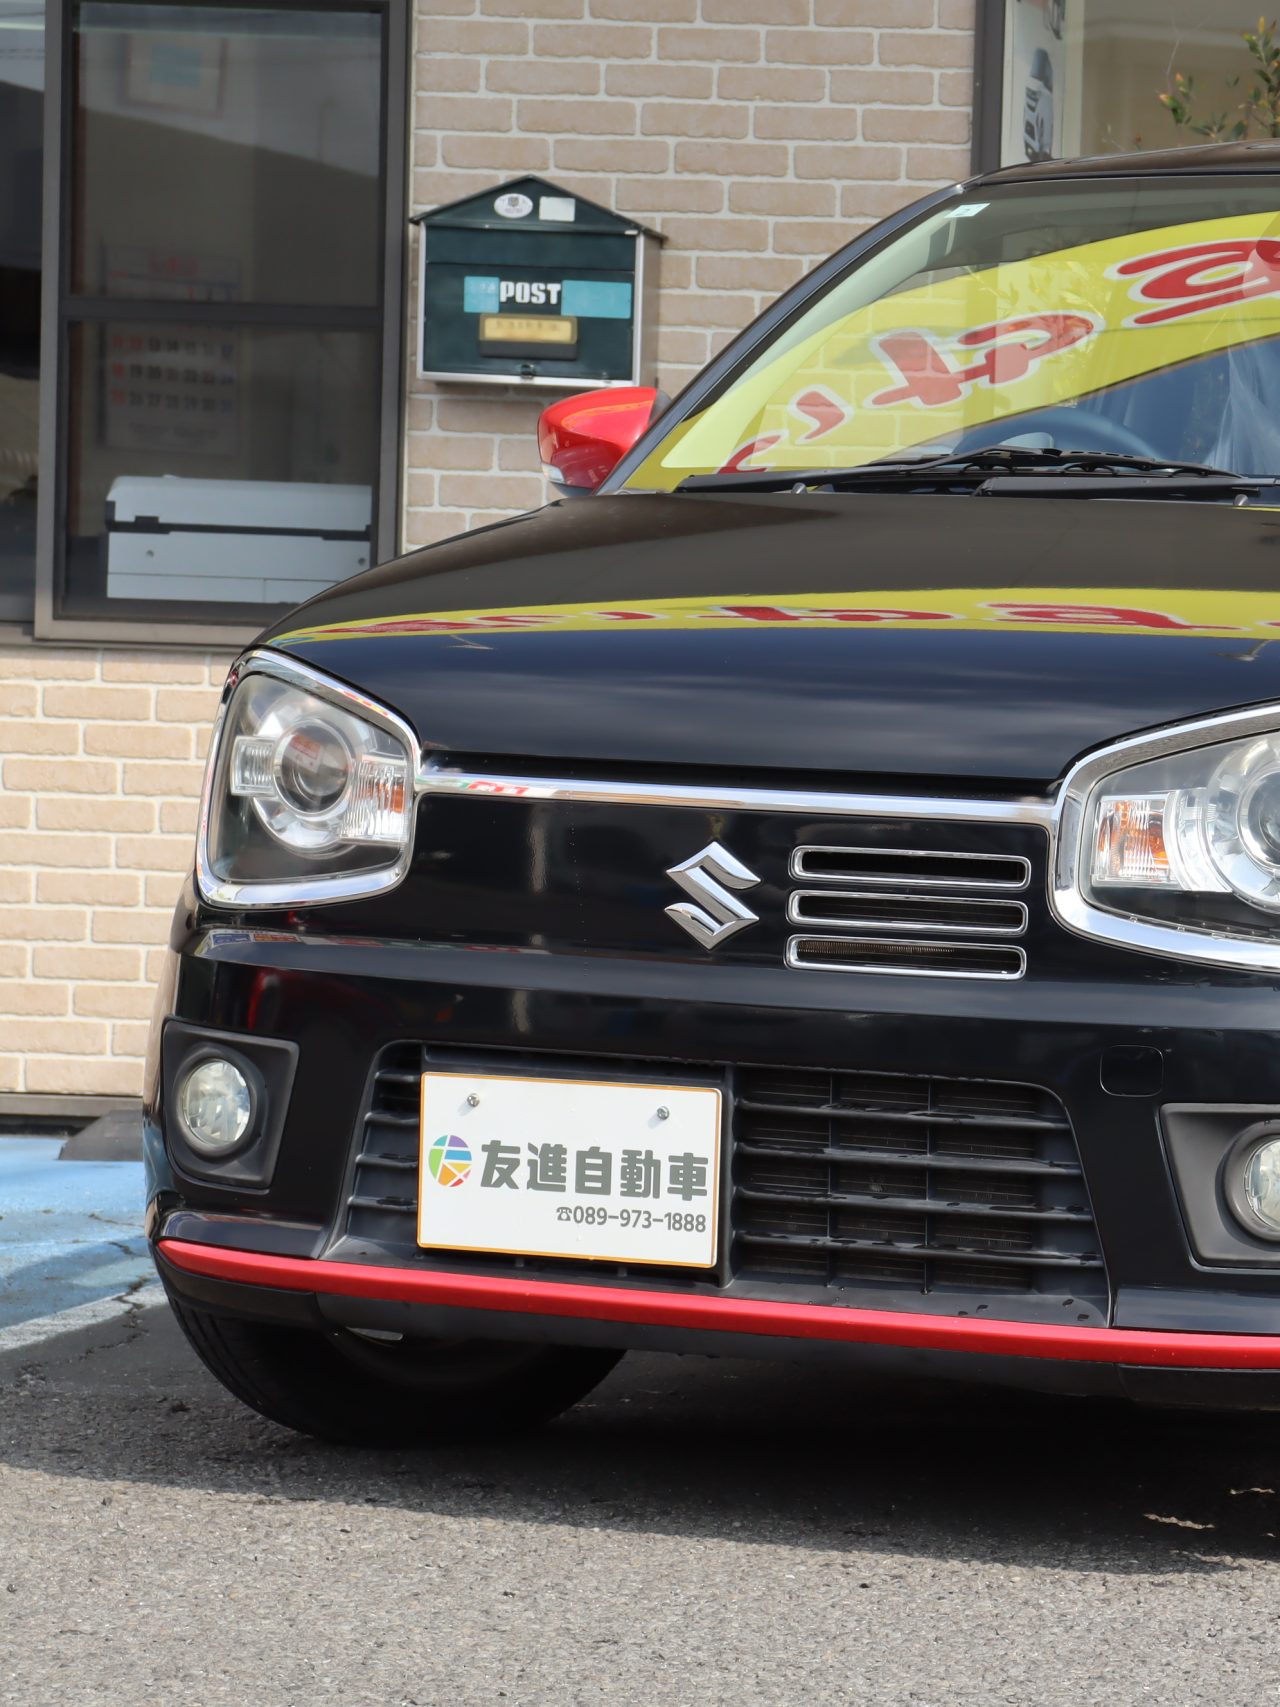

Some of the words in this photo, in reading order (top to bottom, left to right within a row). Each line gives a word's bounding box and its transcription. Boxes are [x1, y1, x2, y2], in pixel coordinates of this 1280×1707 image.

[500, 280, 561, 304] POST
[479, 1139, 709, 1202] 友進自動車
[572, 1205, 707, 1233] 089-973-1888
